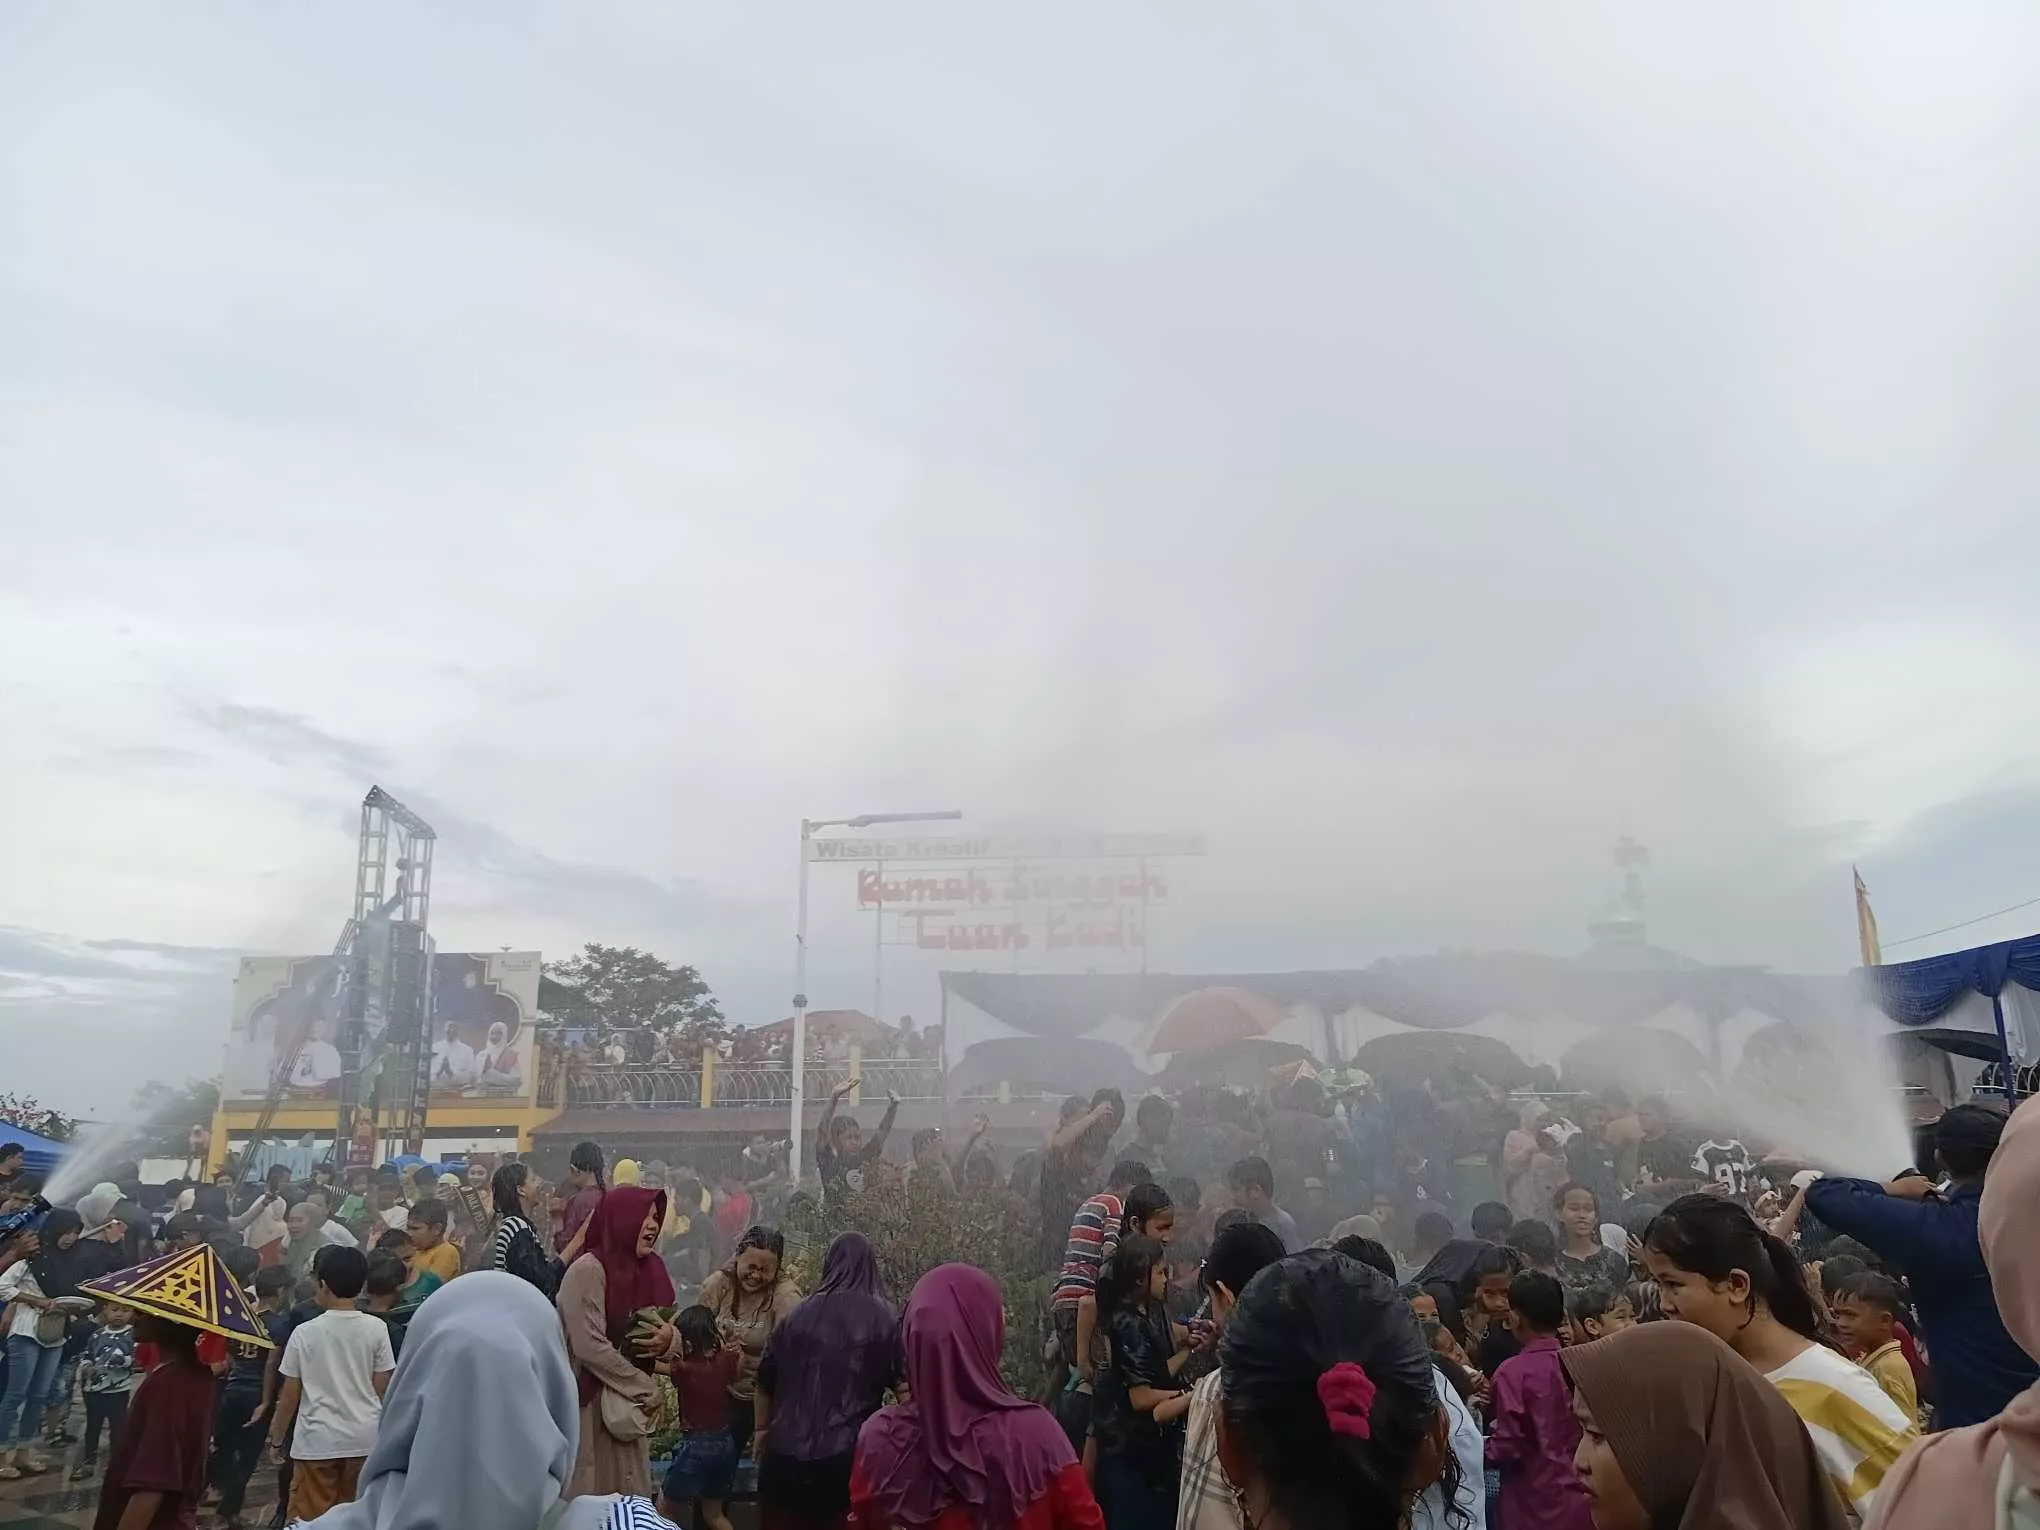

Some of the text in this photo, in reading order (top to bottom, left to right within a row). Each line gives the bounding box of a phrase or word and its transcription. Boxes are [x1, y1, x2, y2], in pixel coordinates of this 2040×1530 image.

[816, 840, 898, 858] Wisata
[905, 838, 991, 857] Kreatif
[858, 868, 992, 907] Rumah
[903, 909, 1029, 949] Tuan
